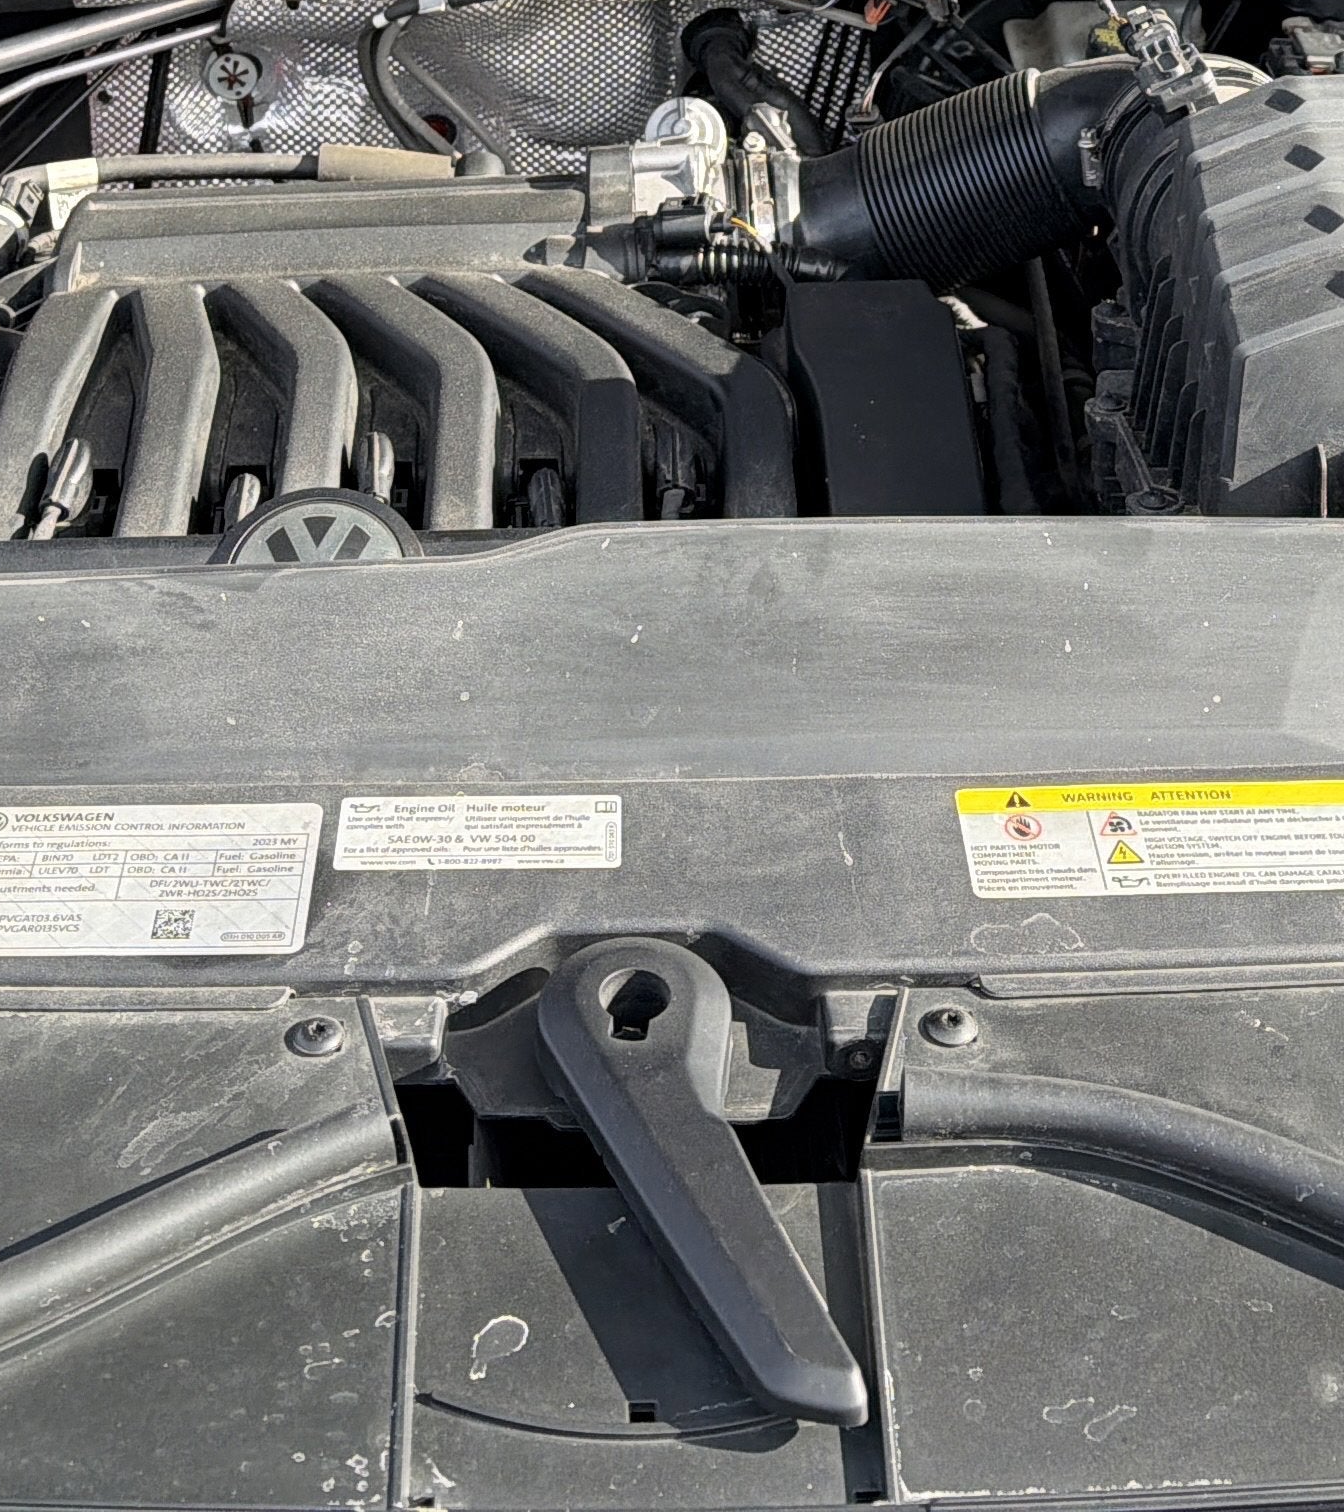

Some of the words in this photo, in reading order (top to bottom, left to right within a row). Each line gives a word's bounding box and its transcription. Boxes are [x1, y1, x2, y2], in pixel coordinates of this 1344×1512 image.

[1061, 791, 1134, 803] WARNING
[1150, 789, 1232, 801] ATTENTION
[394, 804, 435, 815] Engine
[437, 804, 455, 813] Oil
[466, 803, 498, 813] Huile
[501, 804, 546, 813] moteur
[14, 812, 115, 823] VOLKSWAGEN
[11, 824, 55, 832] VEHICLE
[114, 823, 165, 831] CONTROL
[167, 822, 246, 830] INFORMATION
[252, 838, 277, 846] 2023
[280, 838, 298, 846] MY
[470, 834, 491, 843] VW
[494, 834, 517, 843] 504
[520, 834, 536, 843] 00
[32, 841, 44, 849] to
[46, 840, 111, 850] regulations:
[463, 845, 482, 853] Pour
[391, 846, 431, 855] approved
[42, 854, 74, 862] BIN70
[92, 853, 119, 861] LDT2
[130, 853, 158, 861] OBD:
[163, 853, 178, 861] CA
[219, 852, 244, 860] Fuel:
[249, 852, 296, 860] Gasoline
[38, 866, 78, 875] ULEV70
[89, 866, 110, 874] LDT
[127, 866, 156, 874] OBD:
[160, 866, 176, 874] CA
[216, 865, 242, 874] Fuel:
[247, 865, 294, 873] Gasoline
